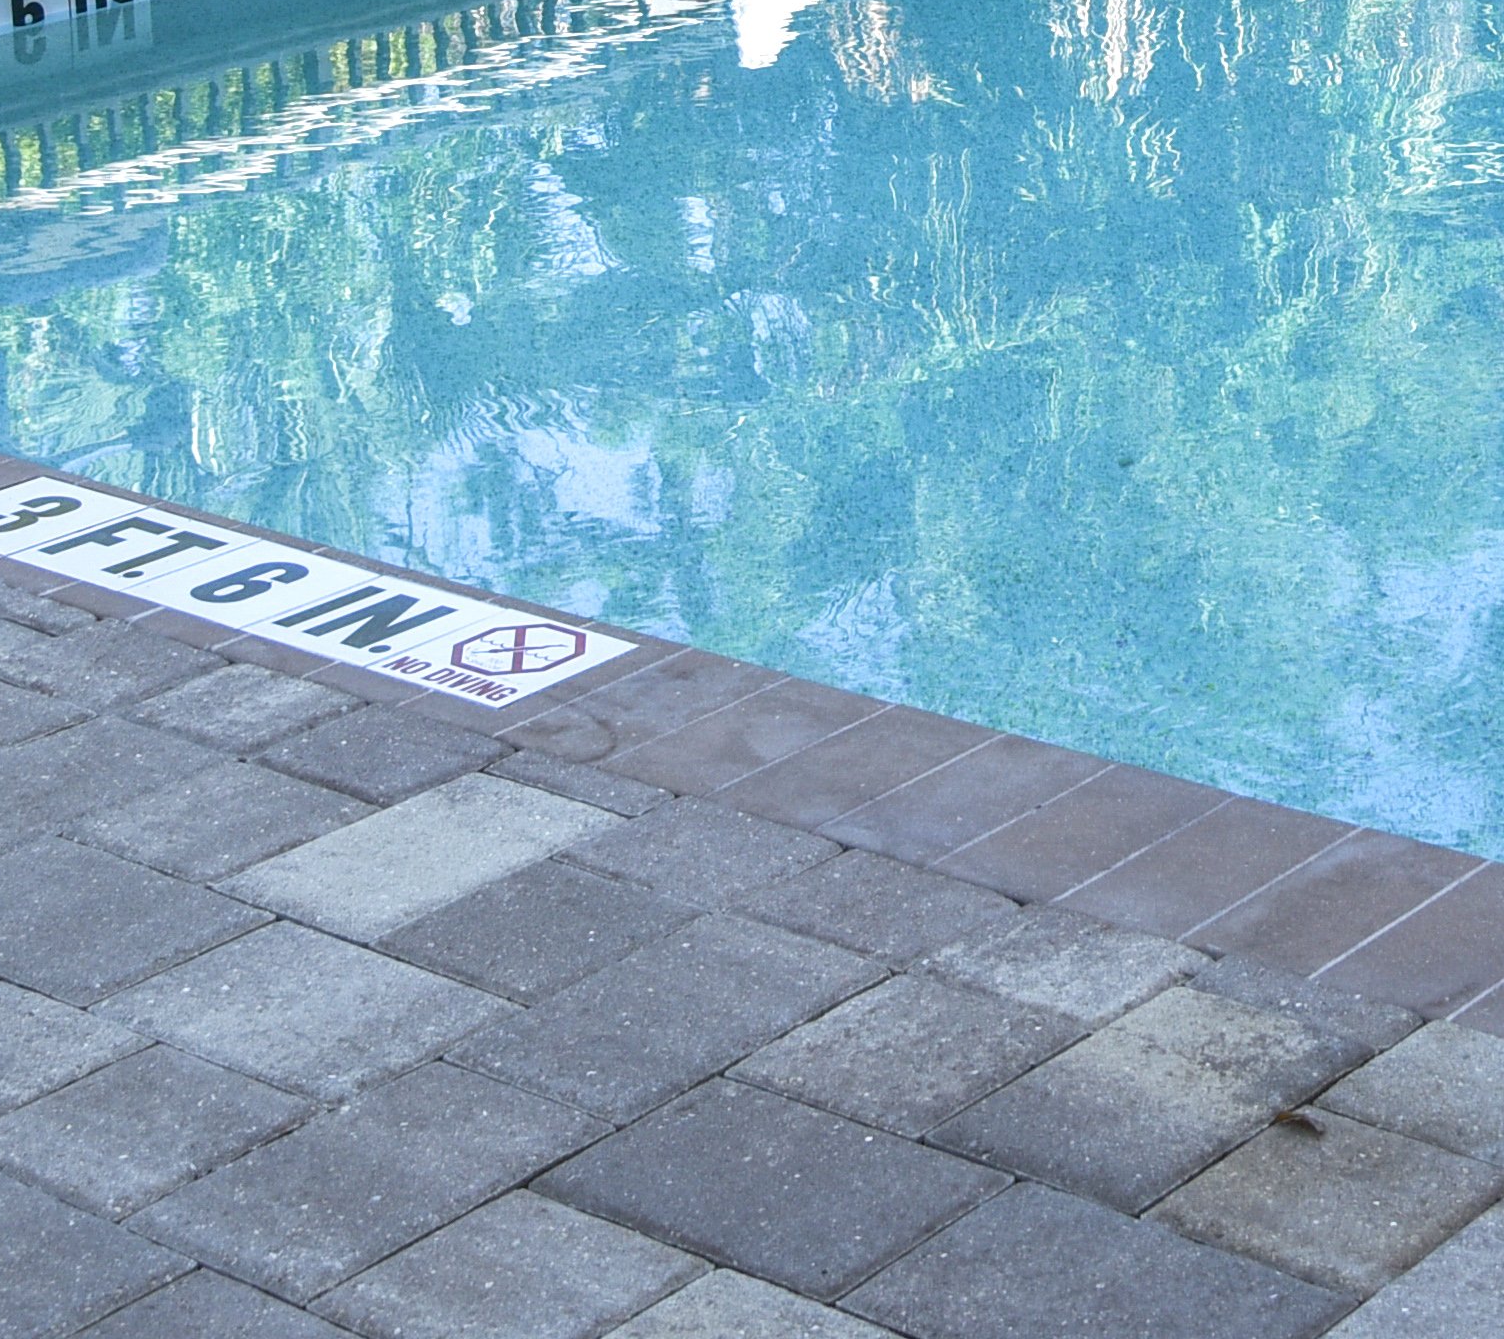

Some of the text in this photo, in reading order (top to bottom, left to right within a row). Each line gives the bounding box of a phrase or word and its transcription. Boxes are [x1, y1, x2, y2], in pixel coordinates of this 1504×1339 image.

[38, 516, 228, 579] FT.
[190, 561, 309, 604] 6
[271, 586, 458, 654] IN.
[382, 656, 518, 702] NO DIVING
